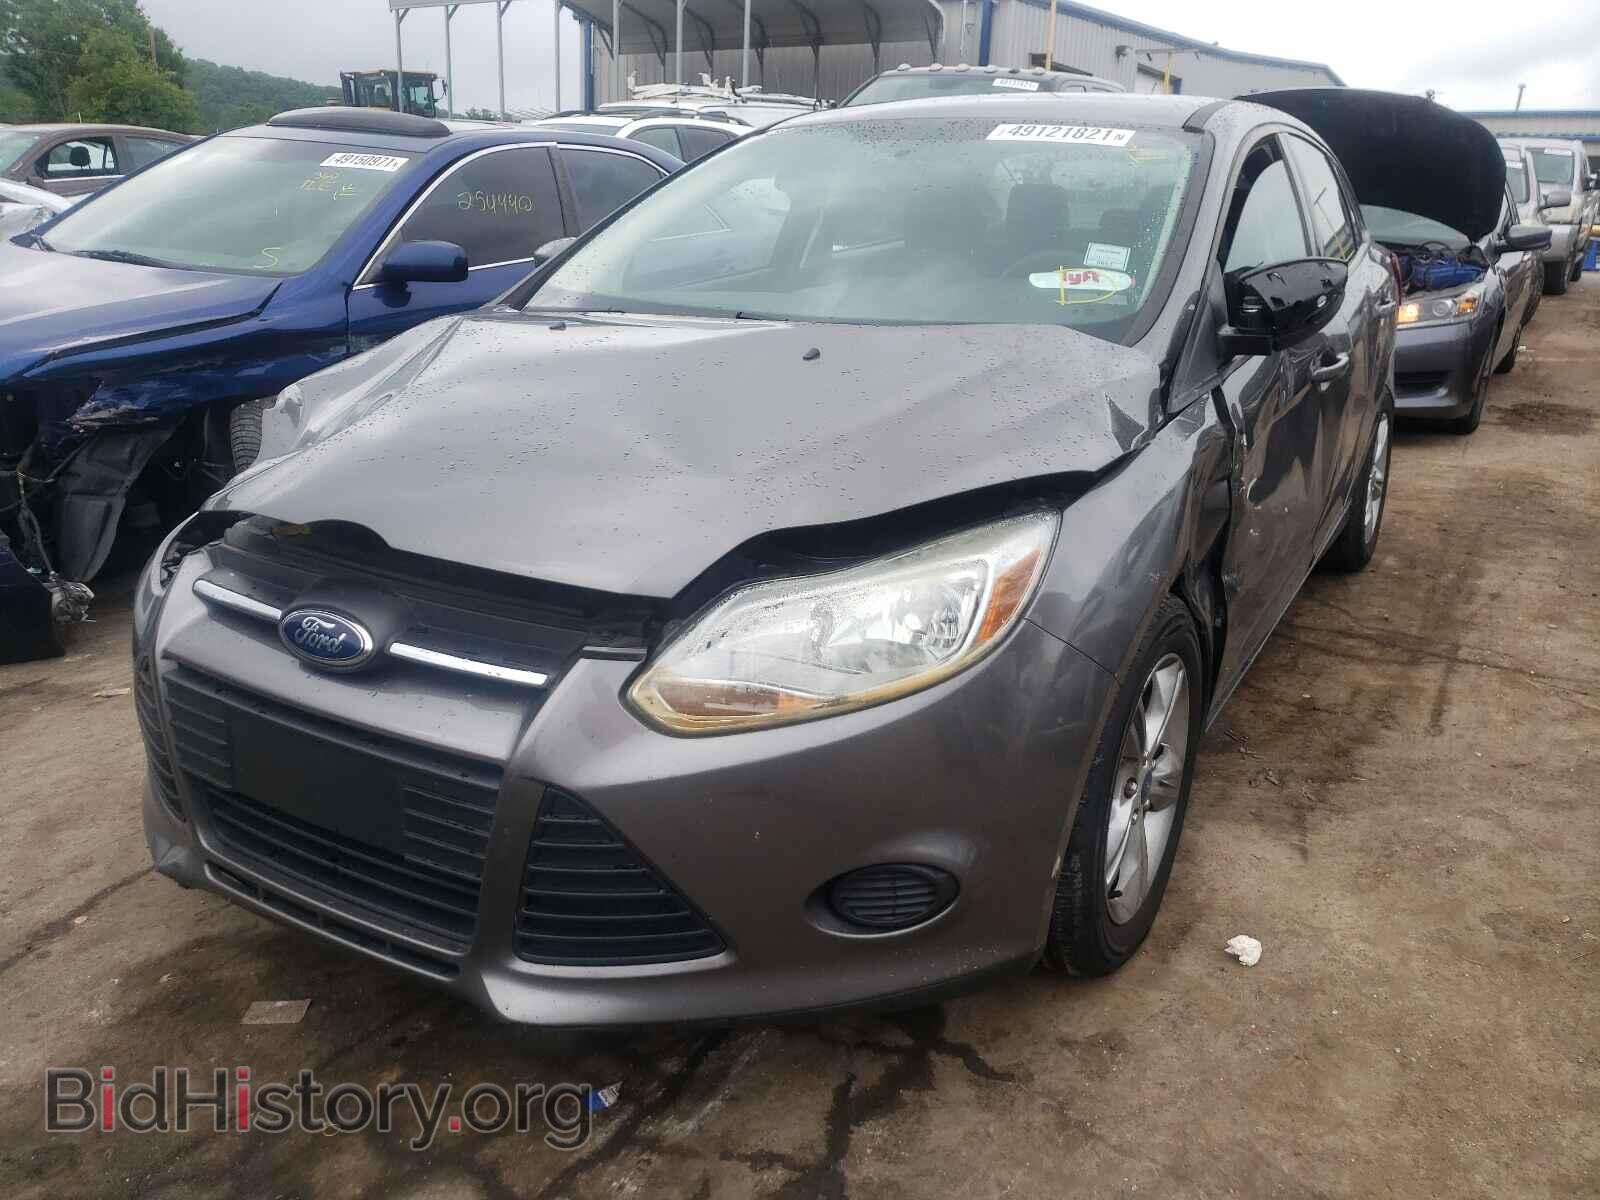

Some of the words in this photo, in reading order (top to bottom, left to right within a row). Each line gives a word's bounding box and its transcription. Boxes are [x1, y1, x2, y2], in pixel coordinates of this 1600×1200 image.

[1008, 125, 1113, 141] 49121821
[334, 153, 395, 167] 49150971
[294, 616, 346, 654] Ford
